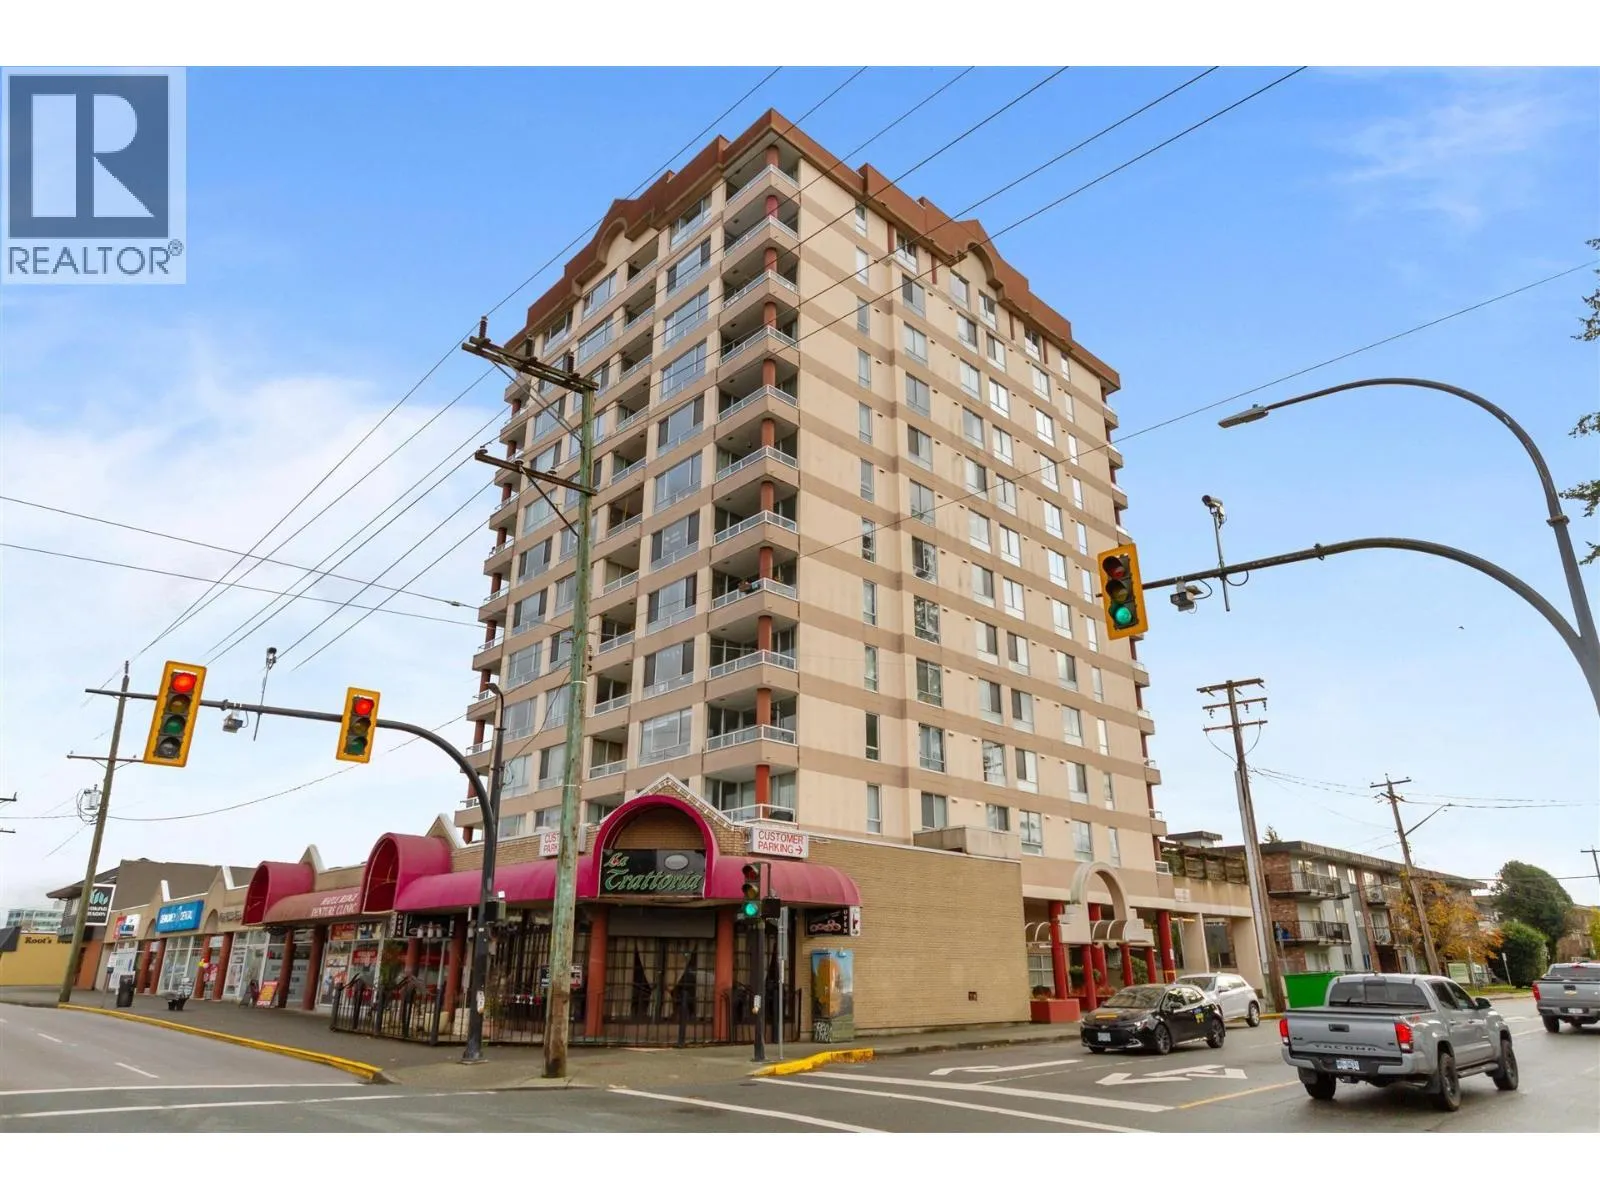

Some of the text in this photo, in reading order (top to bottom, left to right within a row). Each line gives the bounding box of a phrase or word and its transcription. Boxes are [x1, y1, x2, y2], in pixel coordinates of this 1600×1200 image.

[758, 830, 804, 845] CUSTOMER
[758, 841, 794, 854] PARKING
[603, 852, 629, 868] La
[604, 868, 702, 890] Trattoria
[1314, 1043, 1377, 1052] TACOMA
